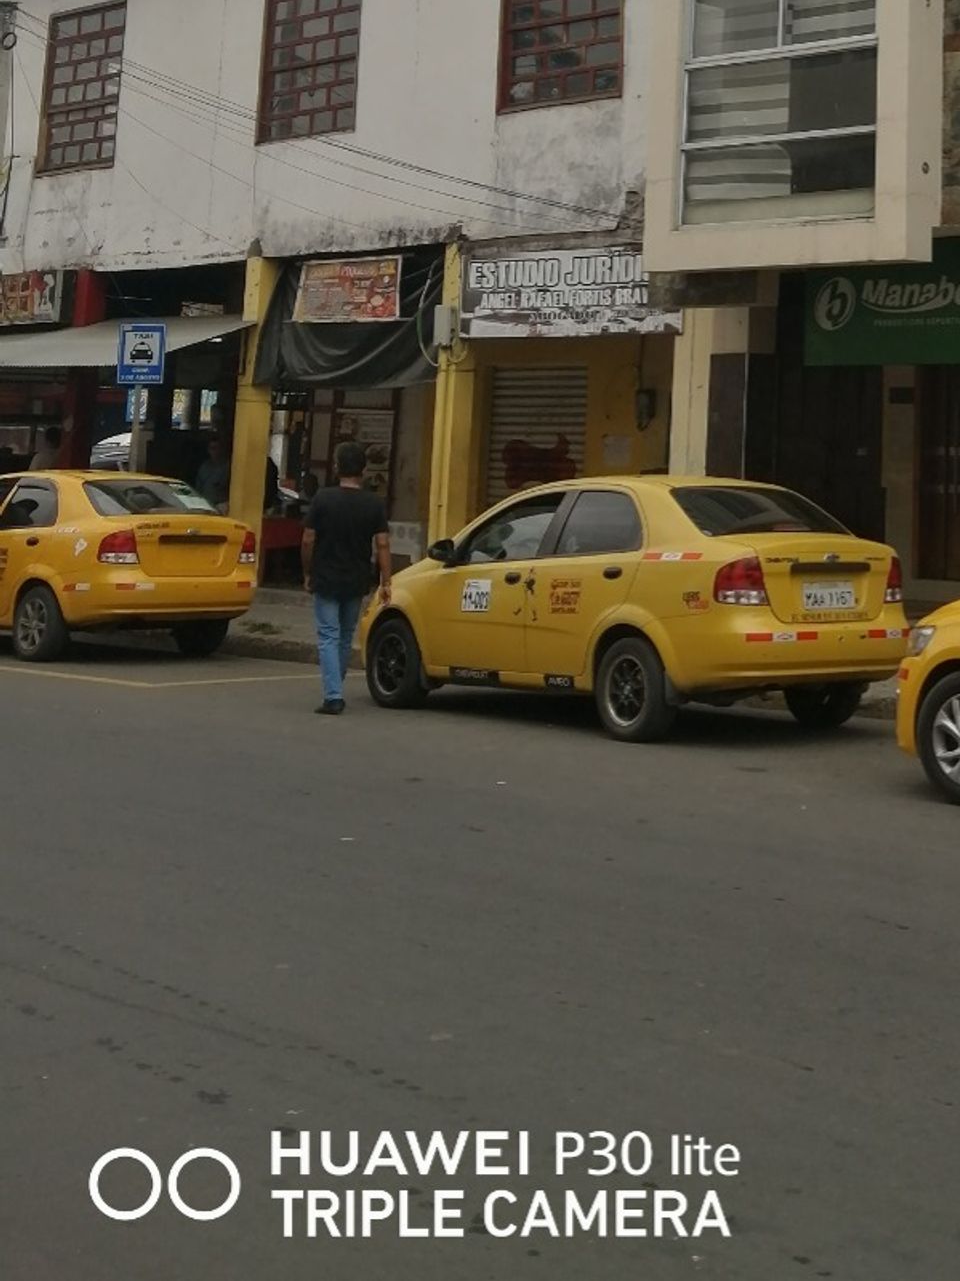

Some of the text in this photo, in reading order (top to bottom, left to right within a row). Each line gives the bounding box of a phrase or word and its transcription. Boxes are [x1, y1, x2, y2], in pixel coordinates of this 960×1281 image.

[469, 259, 560, 289] ESTUDIO
[520, 289, 567, 309] RAFAEL
[548, 676, 572, 688] AVEO
